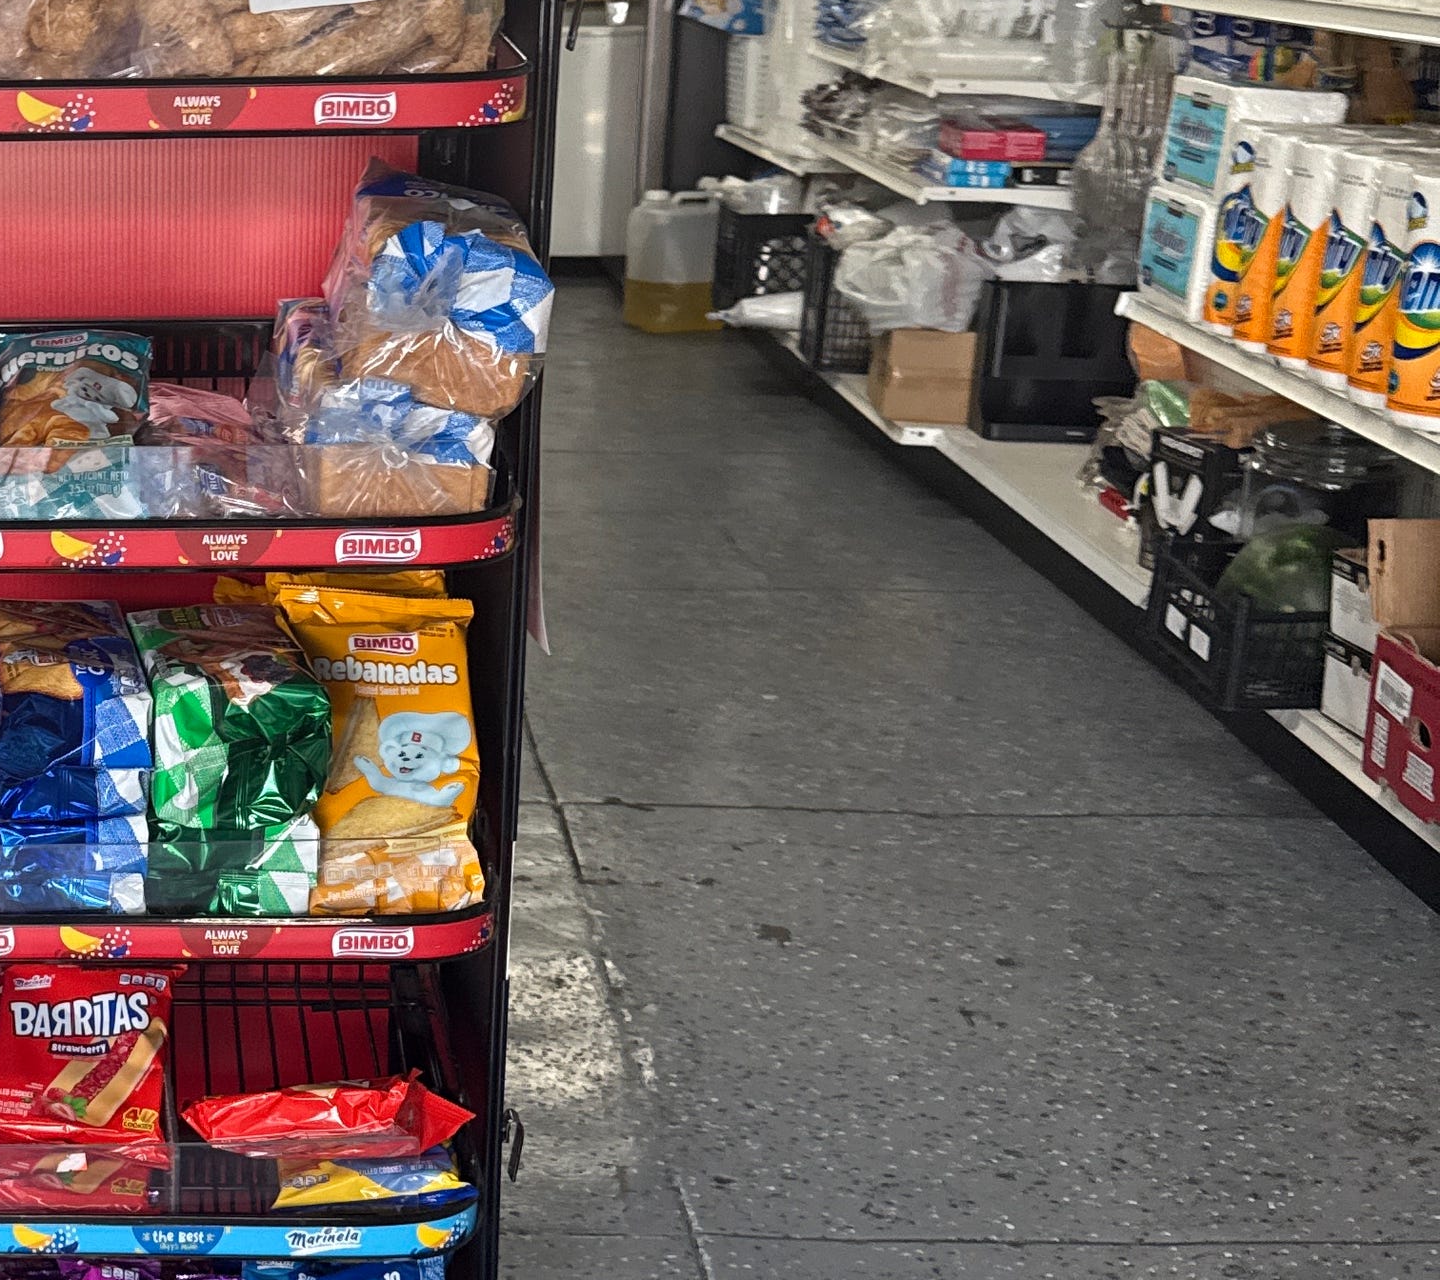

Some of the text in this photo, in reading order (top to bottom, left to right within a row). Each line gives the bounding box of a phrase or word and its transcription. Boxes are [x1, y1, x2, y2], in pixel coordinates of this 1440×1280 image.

[173, 96, 221, 107] ALWAYS
[321, 100, 391, 116] BIMBO
[182, 114, 211, 125] LOVE
[202, 534, 248, 545] ALWAYS
[342, 538, 415, 555] BIMBO
[211, 551, 239, 561] LOVE
[354, 637, 414, 651] BIMBO
[313, 656, 458, 684] Rebanadas
[205, 930, 249, 940] ALWAYS
[338, 935, 408, 950] BIMBO
[213, 946, 240, 955] LOVE
[10, 991, 151, 1038] BARRITAS
[123, 1107, 138, 1121] 4
[378, 1165, 403, 1174] COOKIES
[152, 1230, 204, 1243] the Best
[288, 1227, 359, 1247] Marinela
